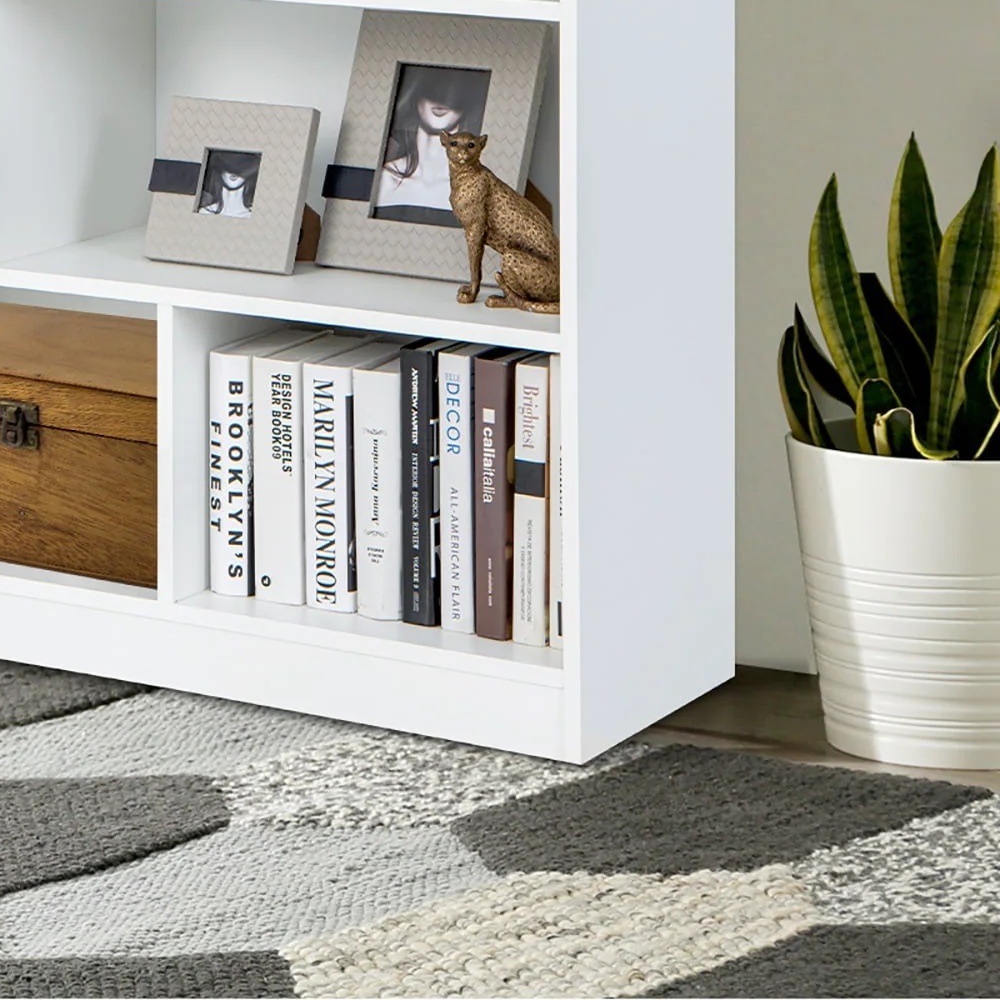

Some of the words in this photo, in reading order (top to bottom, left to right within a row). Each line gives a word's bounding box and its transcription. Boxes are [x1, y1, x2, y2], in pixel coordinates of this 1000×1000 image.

[270, 372, 282, 405] YEAR
[281, 373, 293, 420] DESIGN
[411, 367, 419, 409] ANDREW
[312, 377, 337, 492] MARILYN
[411, 408, 419, 446] MARTIN
[446, 381, 461, 455] DECOR
[517, 384, 540, 449] Brightest
[281, 423, 294, 474] HOTELS
[371, 438, 380, 492] Karenina
[411, 452, 419, 488] INTERIOR
[482, 426, 496, 504] caliaitalia
[210, 420, 222, 533] FINEST
[228, 379, 244, 580] BROOKLYN'S
[371, 495, 380, 526] Anna
[411, 490, 419, 519] DESIGN
[313, 495, 337, 605] MONROE
[411, 521, 419, 551] REVIEW
[450, 486, 461, 581] ALL-AMERICAN
[451, 584, 461, 621] FLAIR
